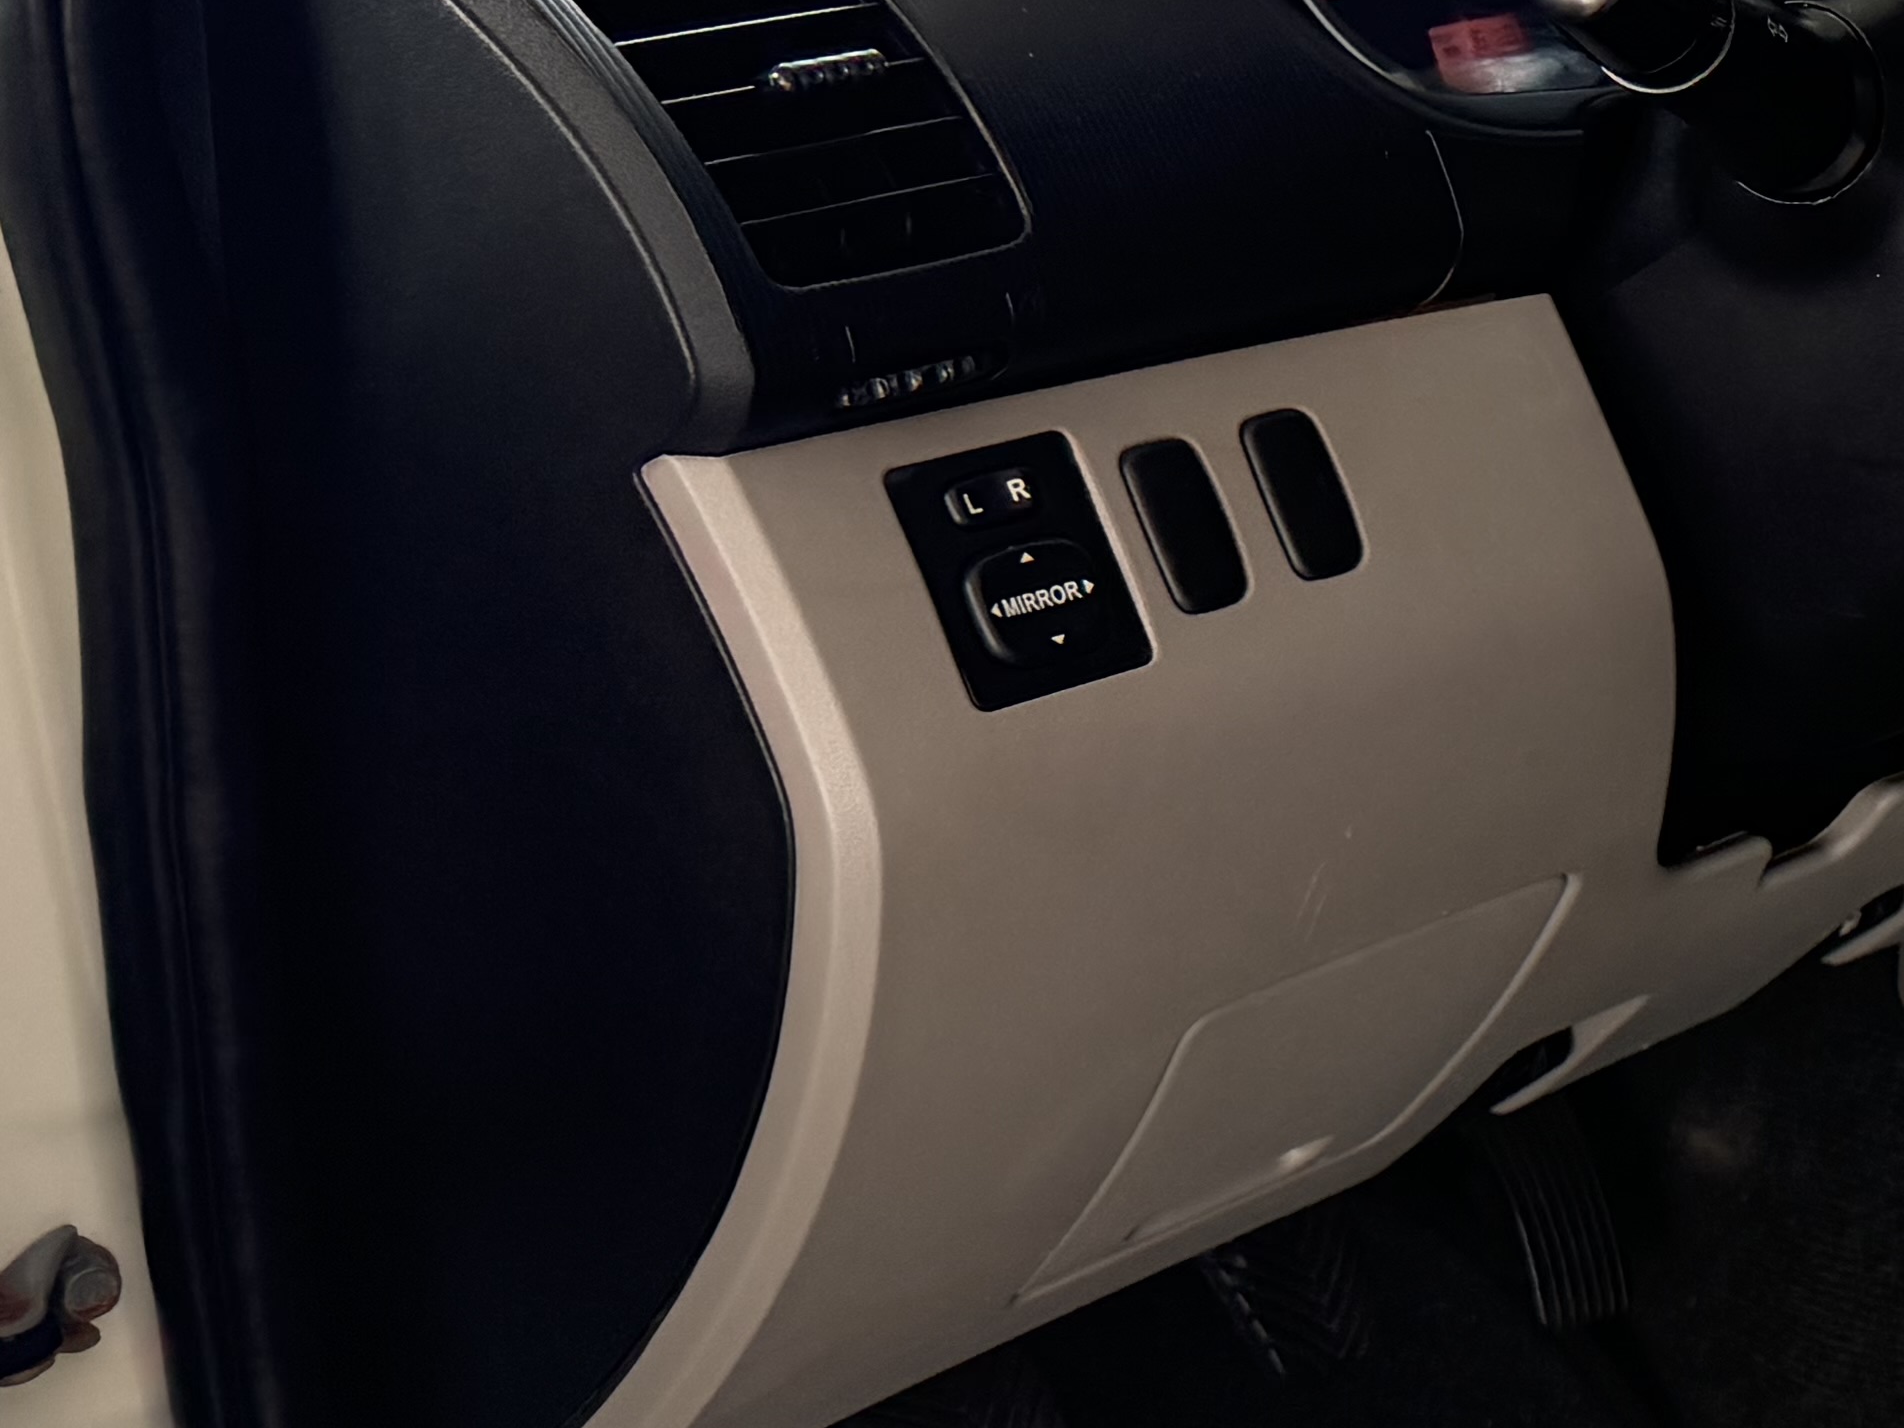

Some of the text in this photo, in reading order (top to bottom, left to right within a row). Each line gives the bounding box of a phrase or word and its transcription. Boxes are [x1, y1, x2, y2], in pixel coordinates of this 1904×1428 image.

[962, 477, 1032, 516] L R
[1001, 580, 1083, 619] MIRROR
